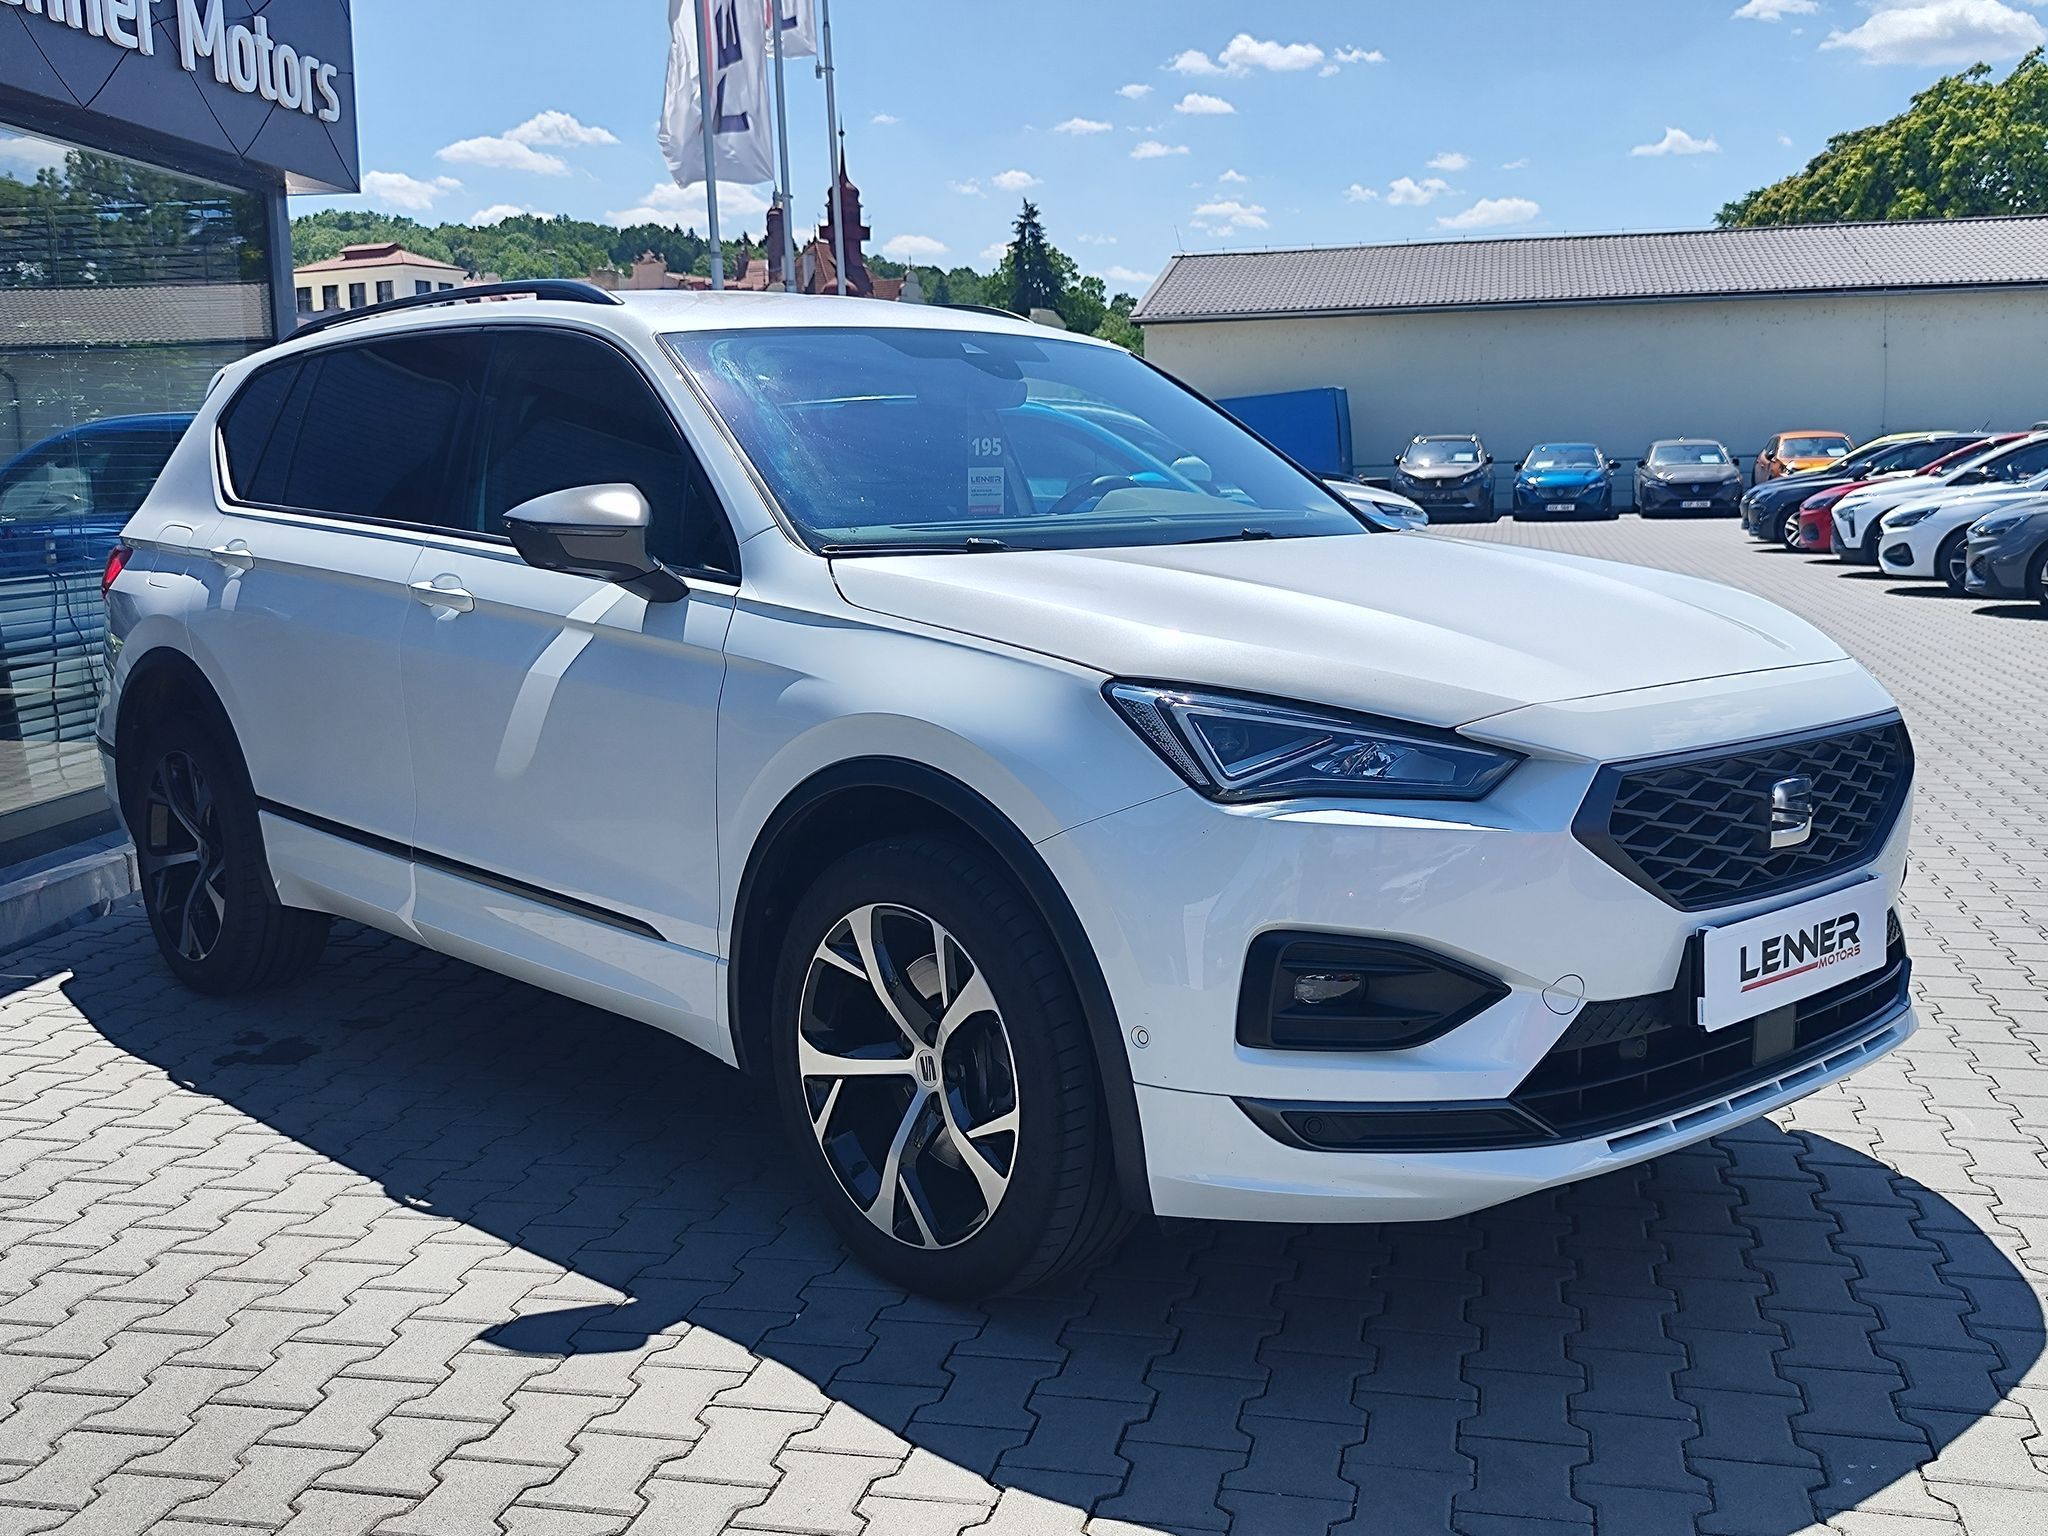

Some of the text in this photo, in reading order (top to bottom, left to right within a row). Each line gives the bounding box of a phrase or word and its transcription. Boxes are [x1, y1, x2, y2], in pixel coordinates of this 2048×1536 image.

[176, 0, 341, 122] Motors
[972, 437, 1002, 456] 195
[1740, 912, 1860, 983] LENNER
[1818, 944, 1861, 969] MOTORS
